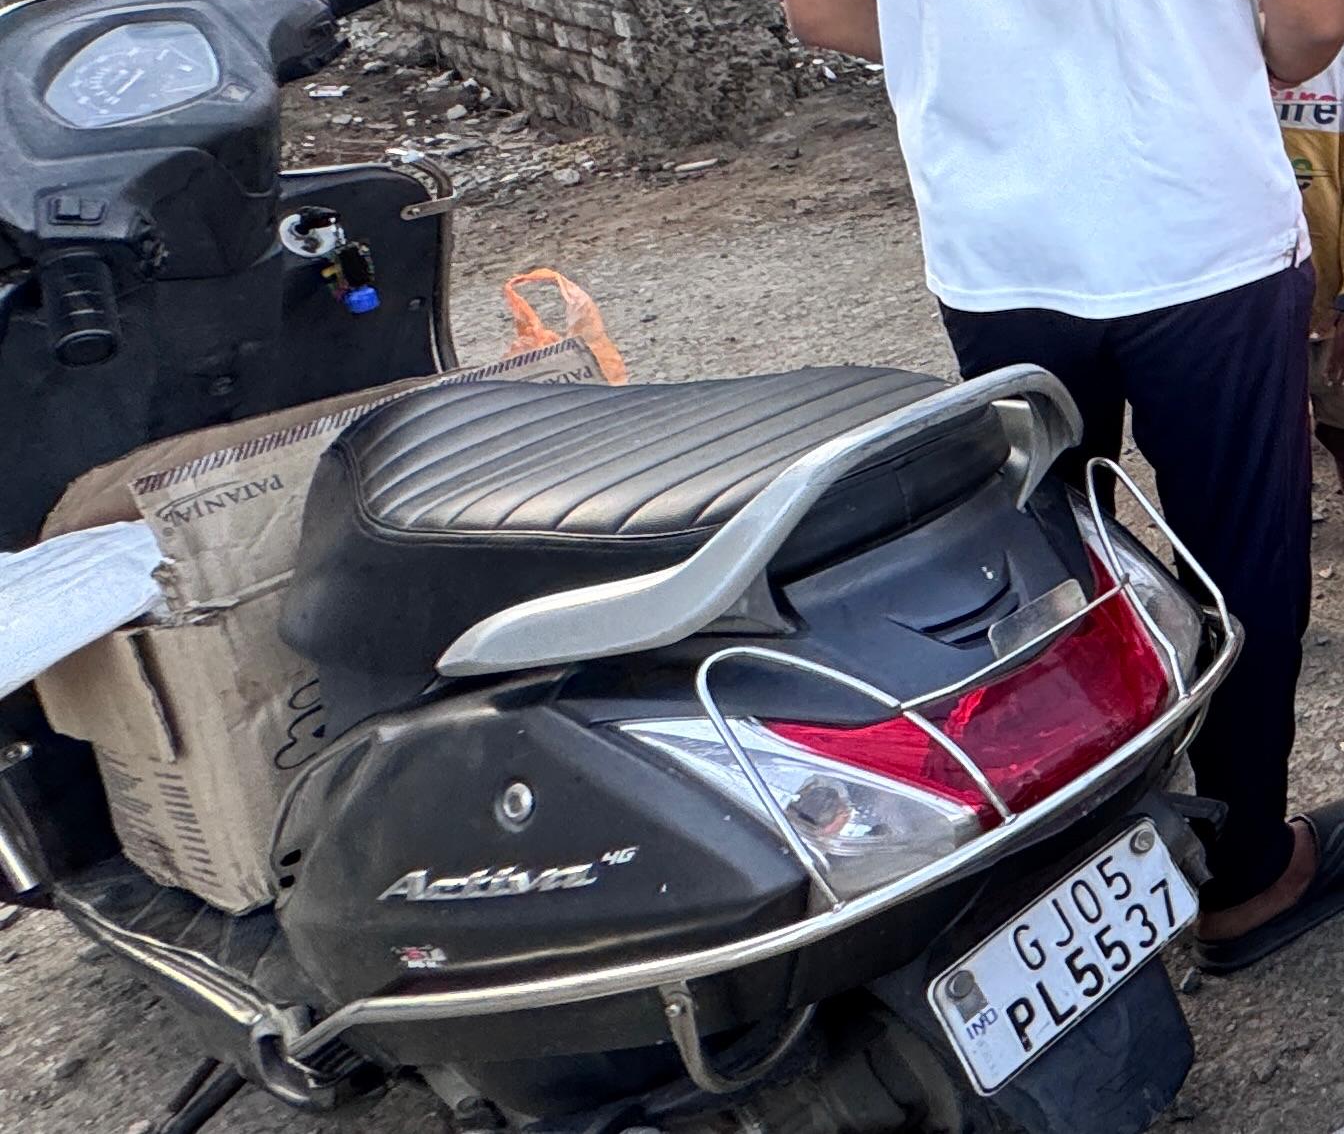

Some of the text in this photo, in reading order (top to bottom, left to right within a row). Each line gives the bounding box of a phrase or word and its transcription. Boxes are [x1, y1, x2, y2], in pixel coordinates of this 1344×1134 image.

[377, 845, 641, 902] Activa 4G
[1005, 878, 1176, 1052] PL5537
[965, 1006, 999, 1041] IND
